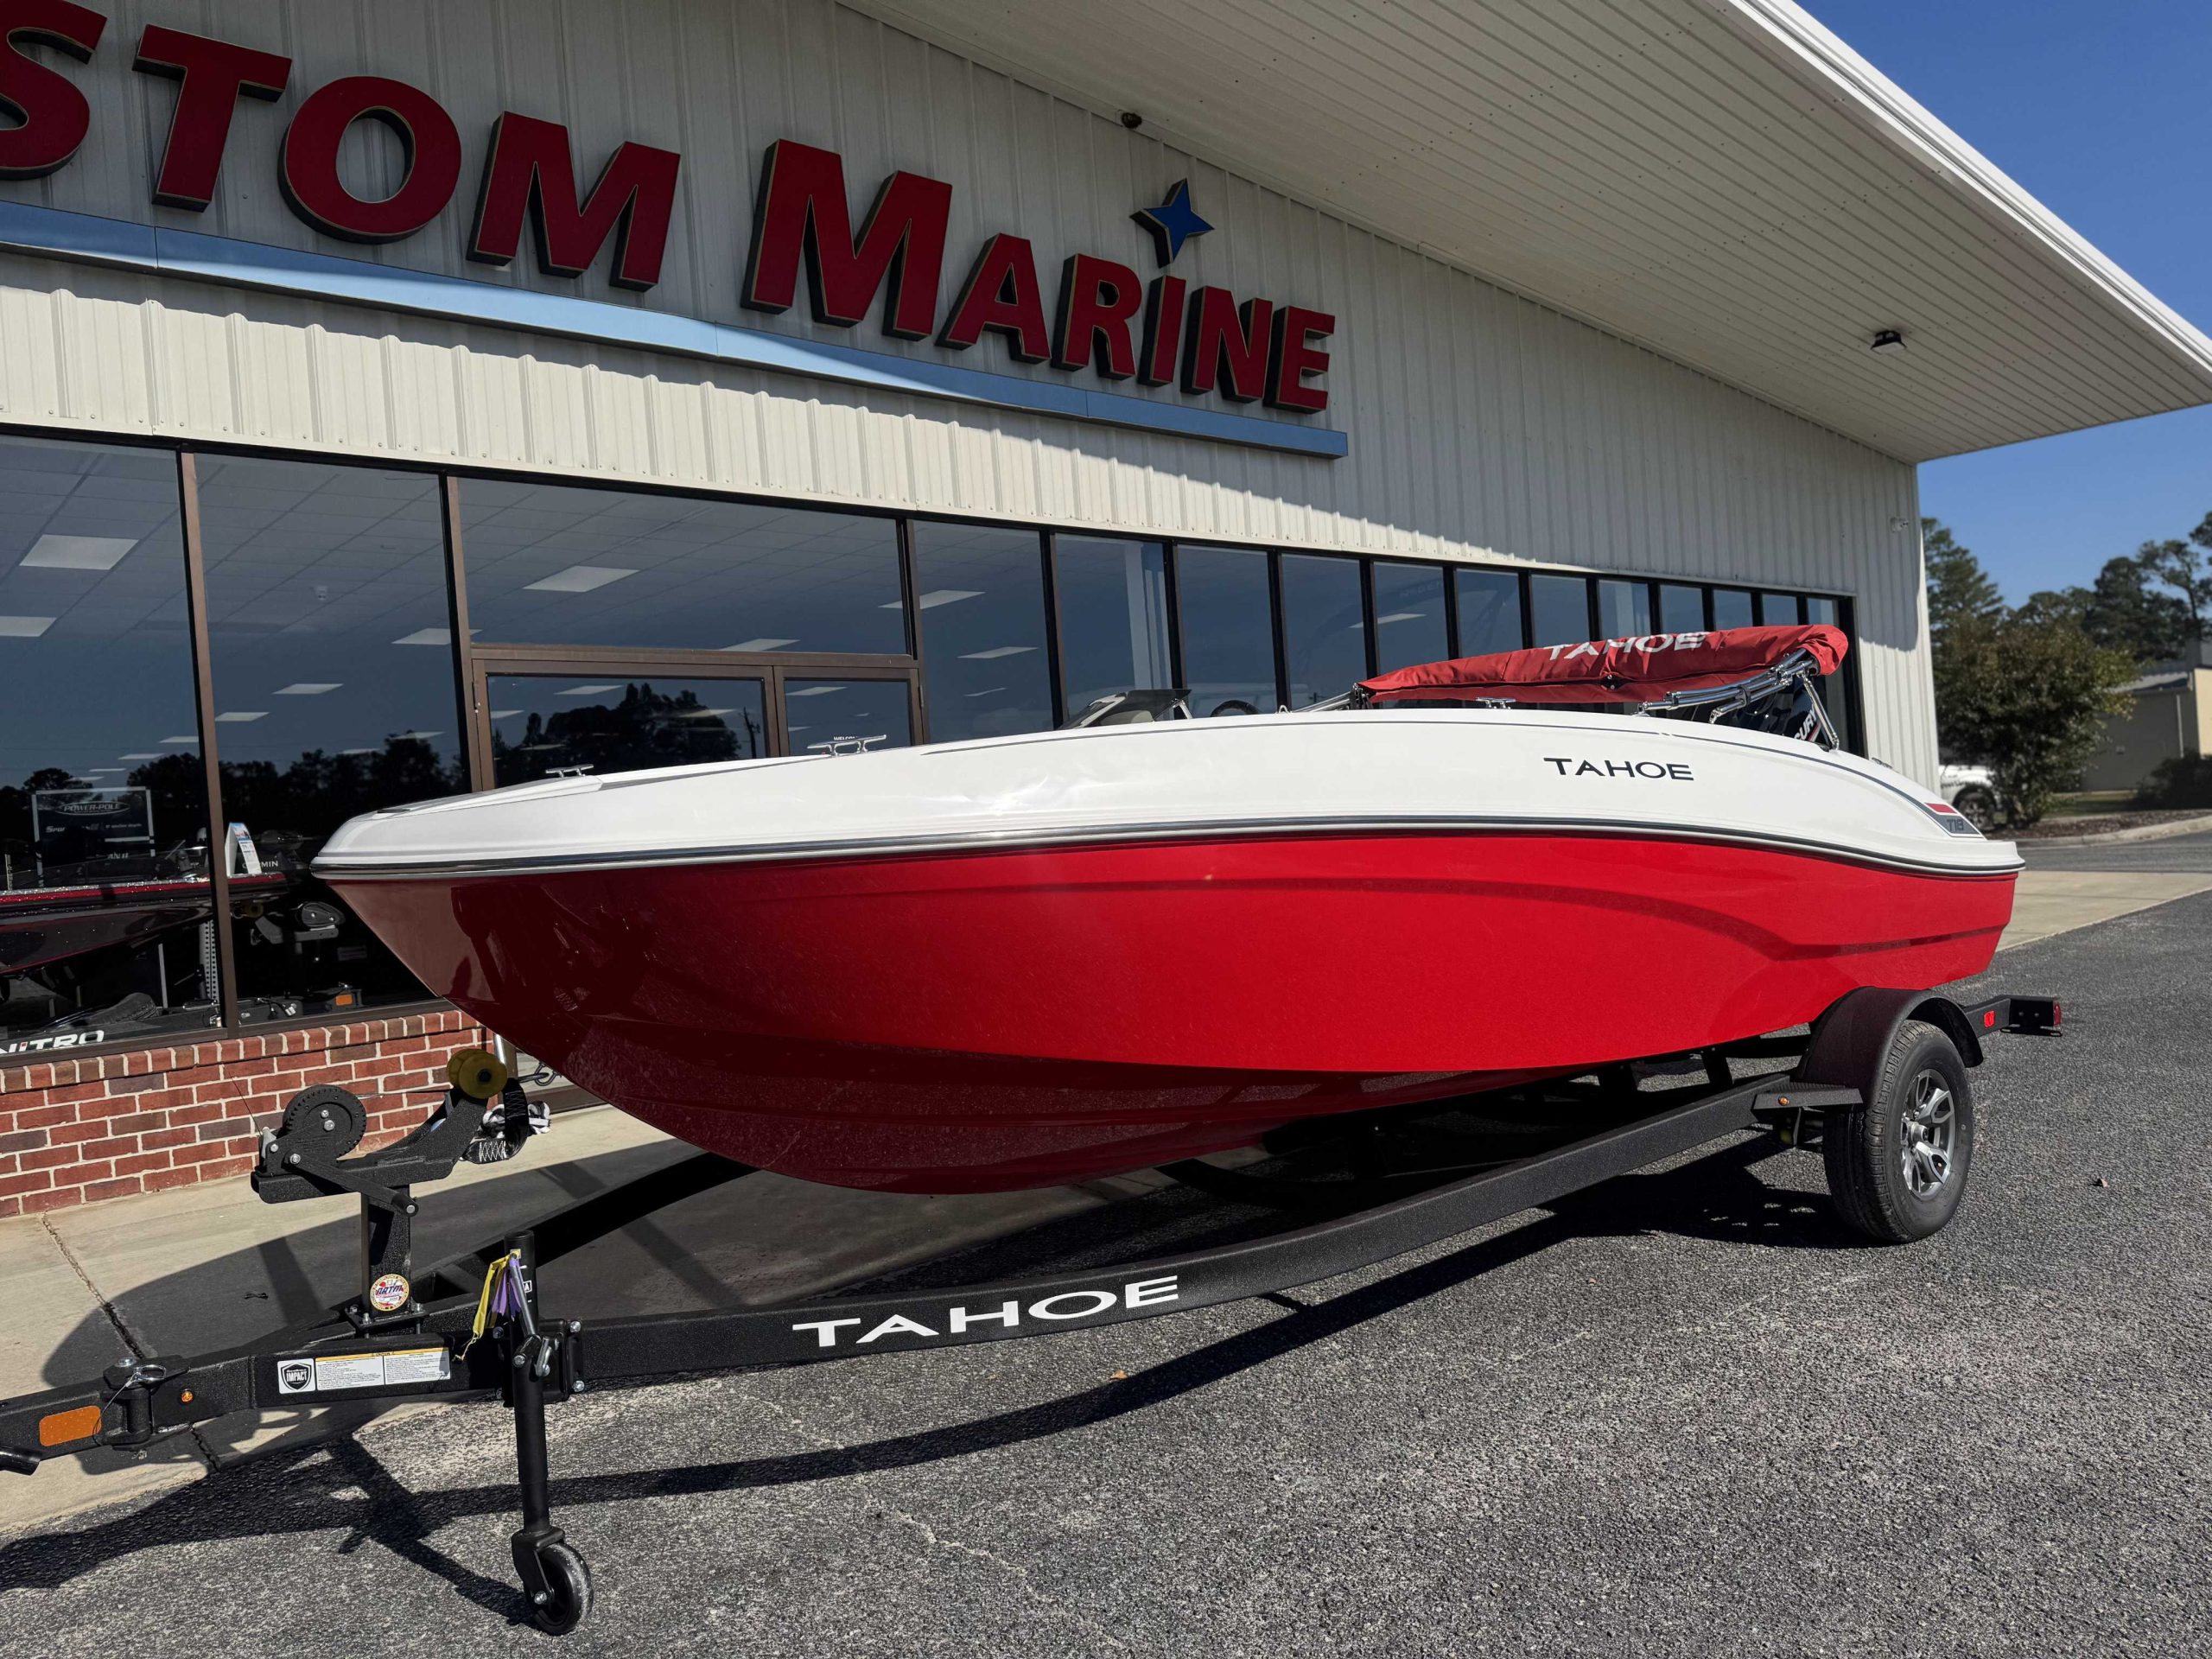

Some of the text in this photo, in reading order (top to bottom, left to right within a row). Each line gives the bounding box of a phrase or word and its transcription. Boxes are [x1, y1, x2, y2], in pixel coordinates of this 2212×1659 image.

[740, 138, 1335, 414] MARINE
[1543, 632, 1711, 660] TAHOE
[1543, 757, 1694, 781] TAHOE
[792, 1275, 1179, 1347] TAHOE
[286, 1371, 307, 1382] IMPACT
